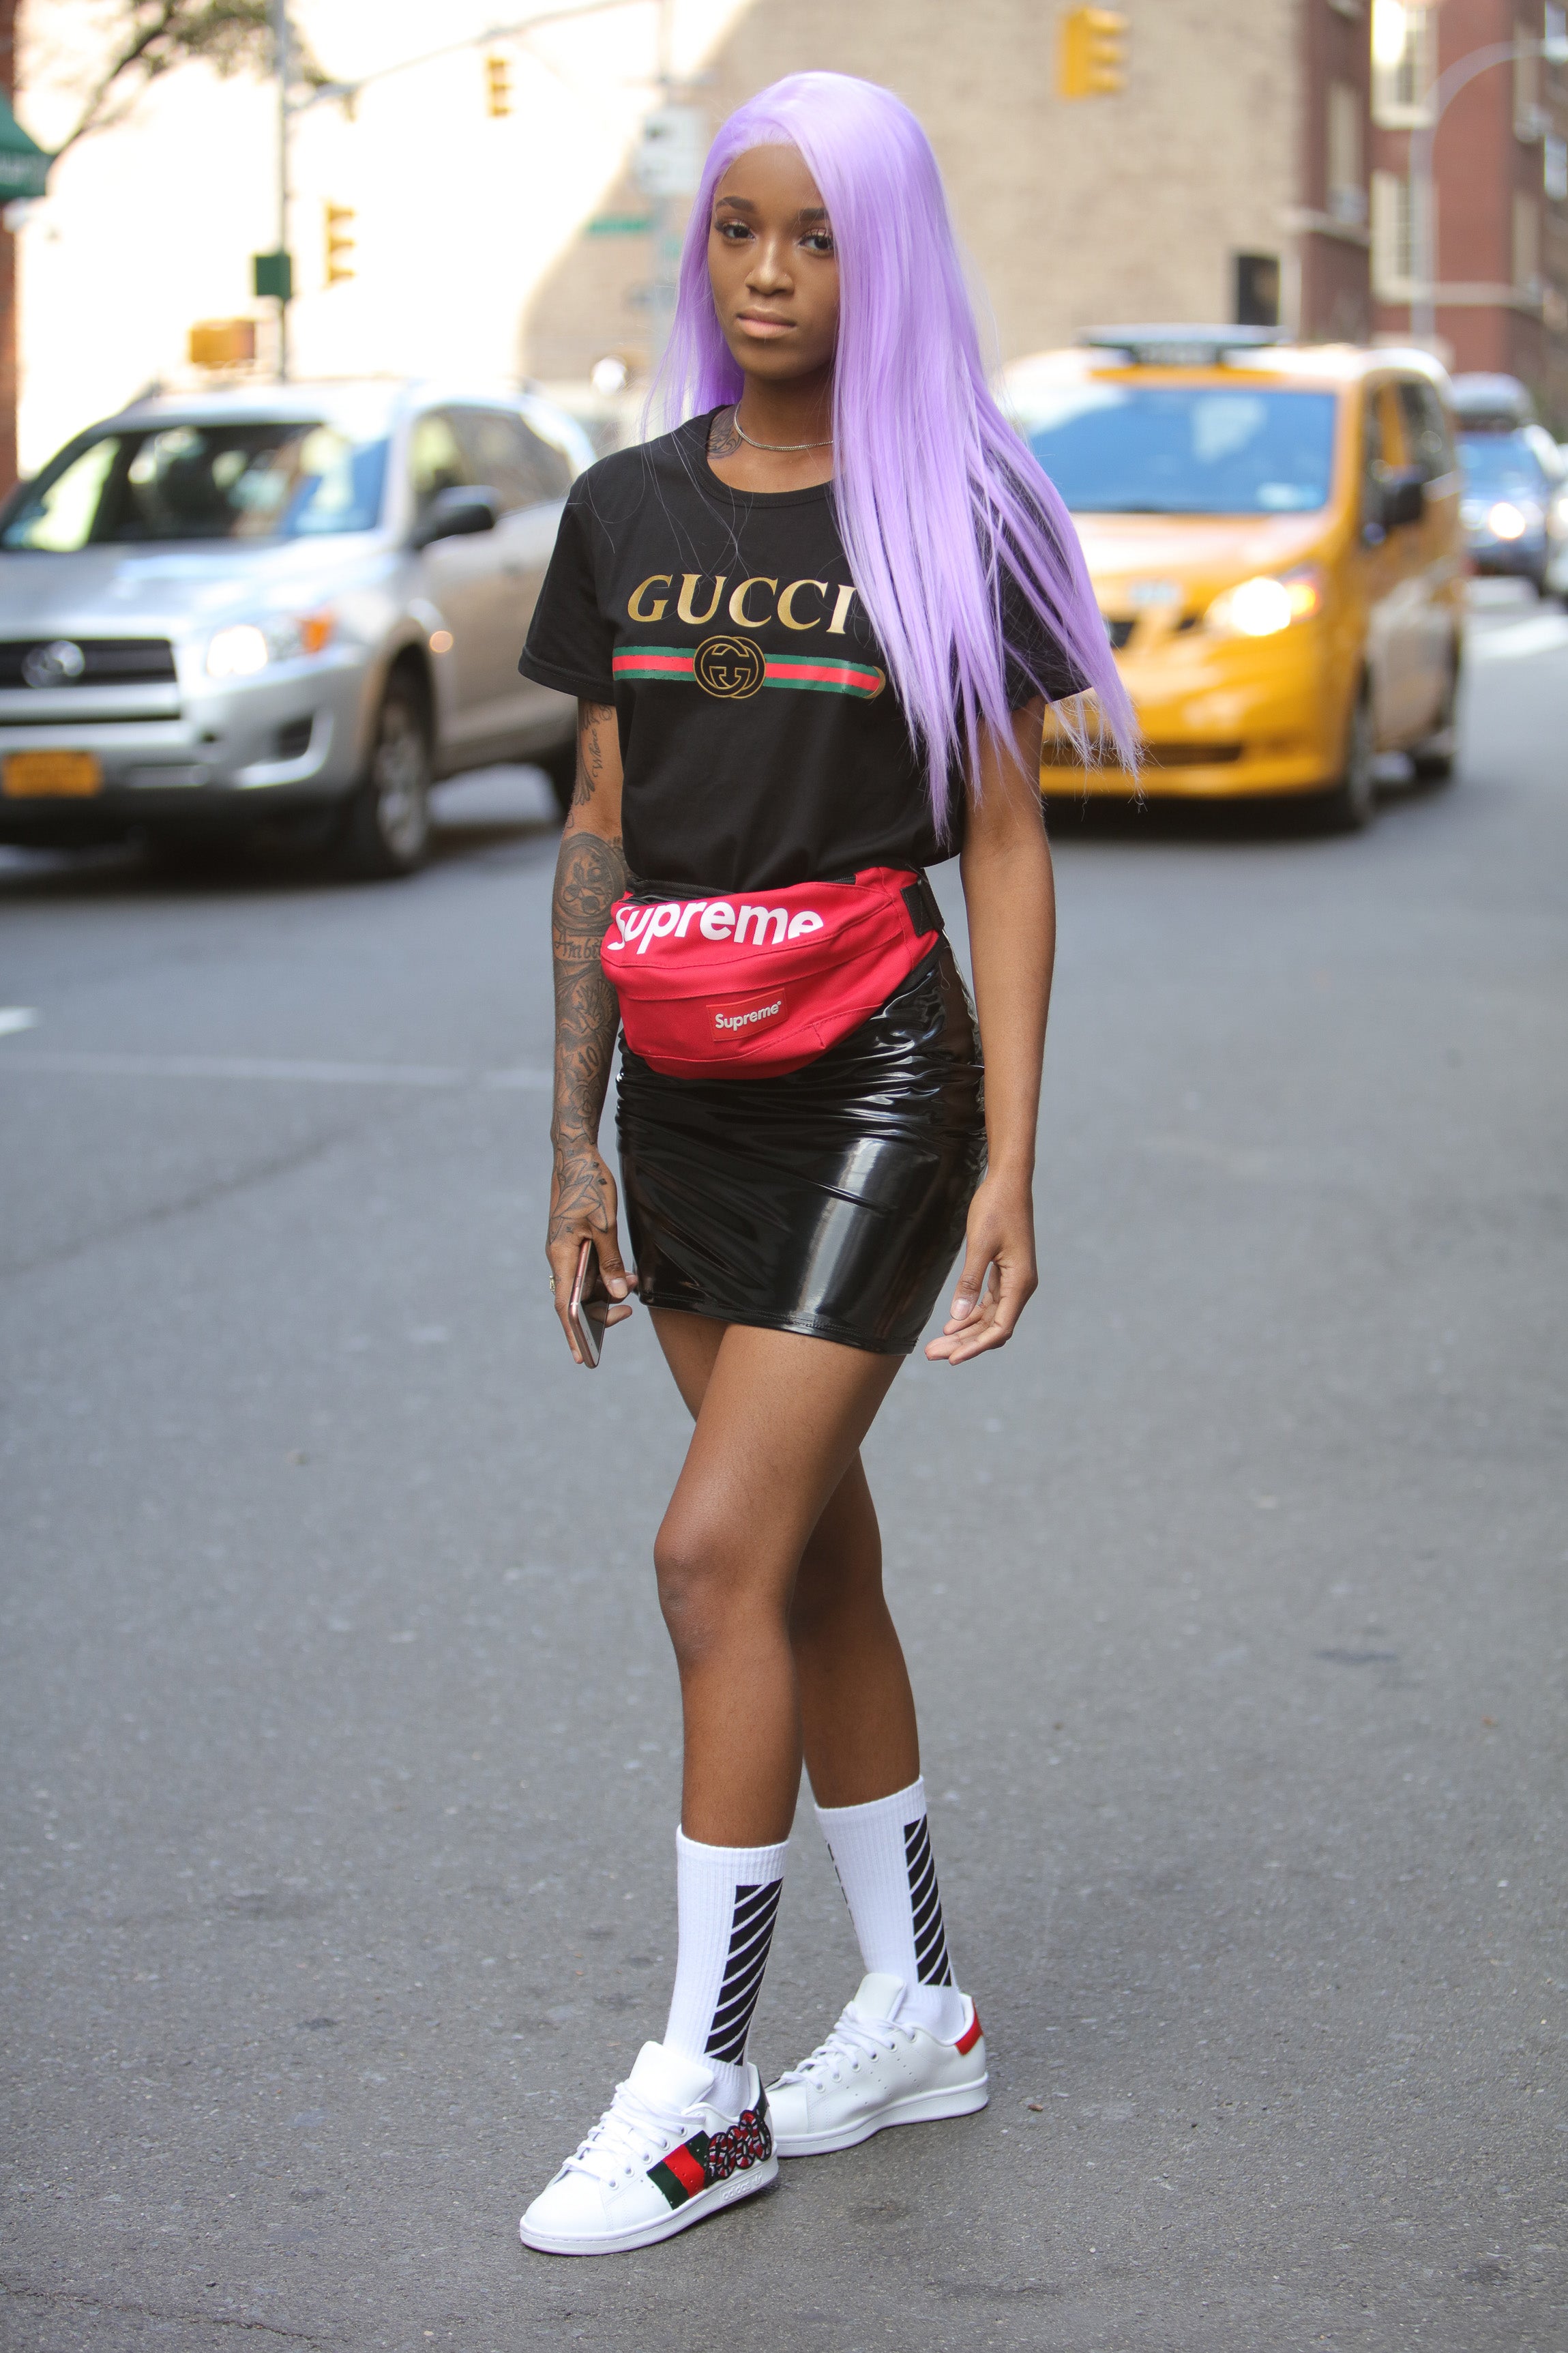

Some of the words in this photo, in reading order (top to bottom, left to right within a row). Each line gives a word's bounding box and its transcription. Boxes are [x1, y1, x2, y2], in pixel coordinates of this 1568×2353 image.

[627, 574, 857, 634] GUCCI
[554, 928, 603, 959] Ambit
[607, 901, 823, 954] Supreme
[723, 2182, 751, 2201] adidas
